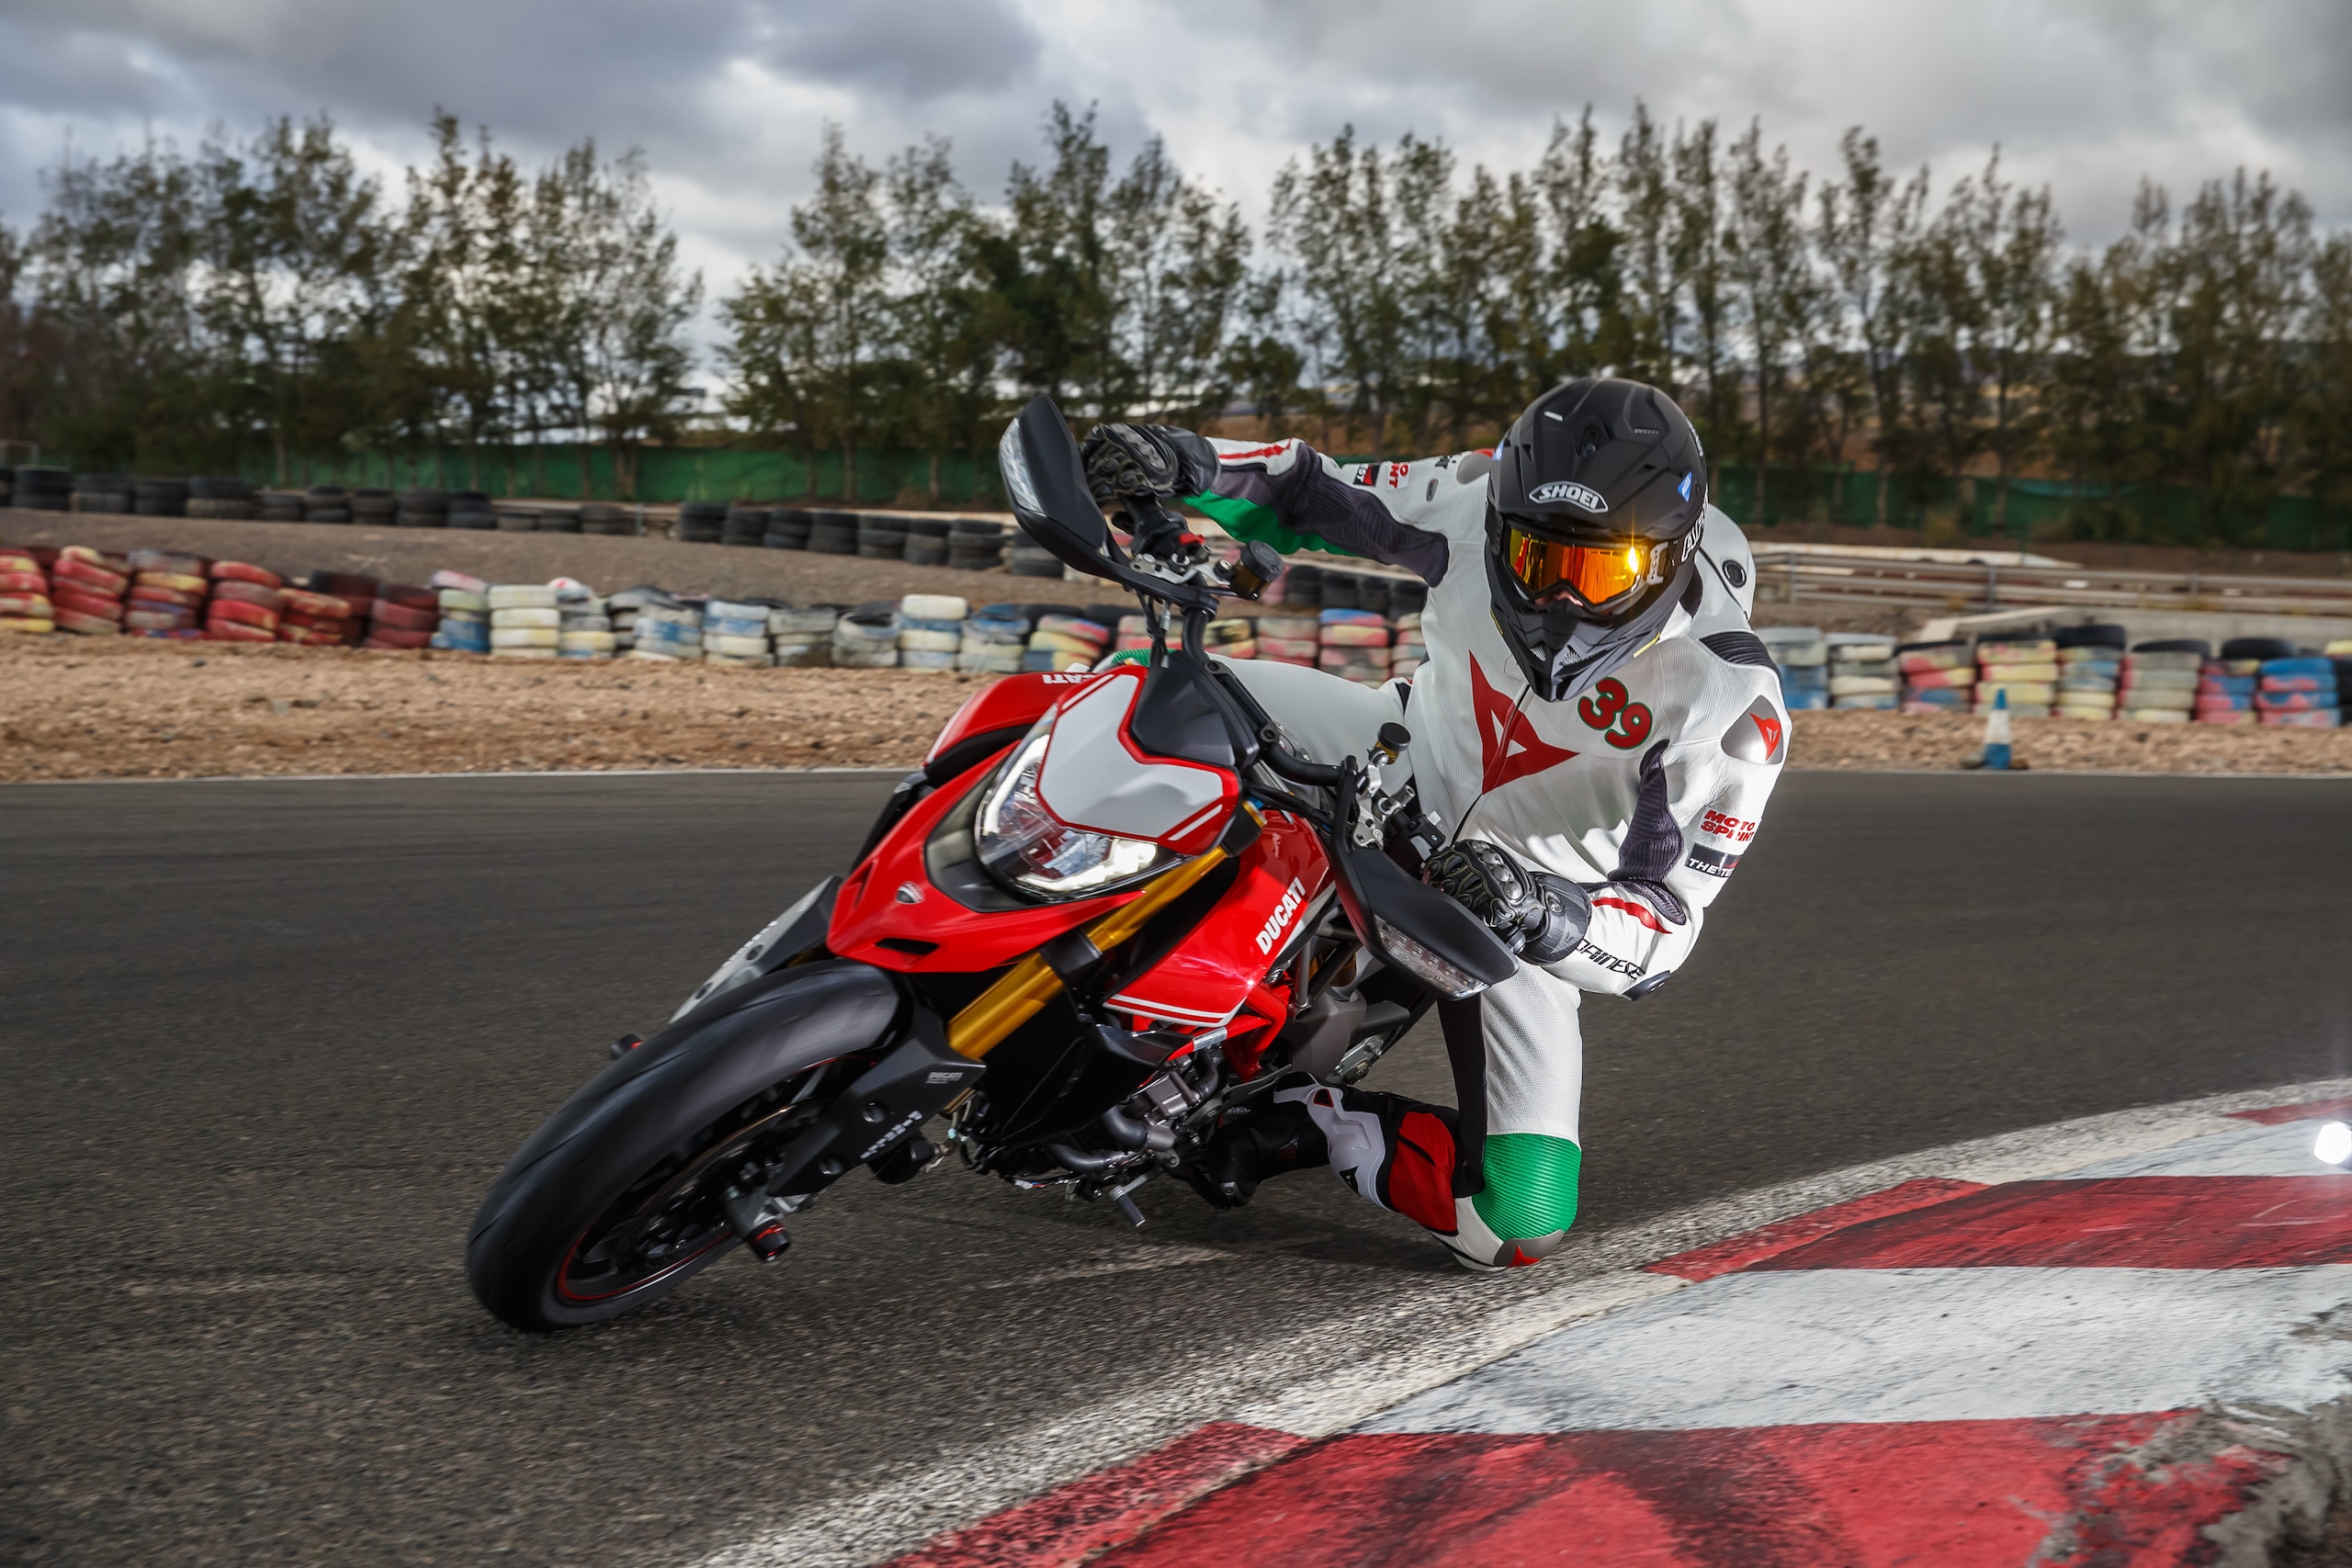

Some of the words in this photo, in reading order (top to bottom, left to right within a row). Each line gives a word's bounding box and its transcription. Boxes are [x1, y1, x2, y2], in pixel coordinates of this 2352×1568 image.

[1538, 484, 1600, 511] SHOEI
[1577, 677, 1653, 750] 39
[1704, 809, 1756, 831] MOTO
[1688, 858, 1720, 874] THE
[1255, 876, 1306, 955] DUCATI
